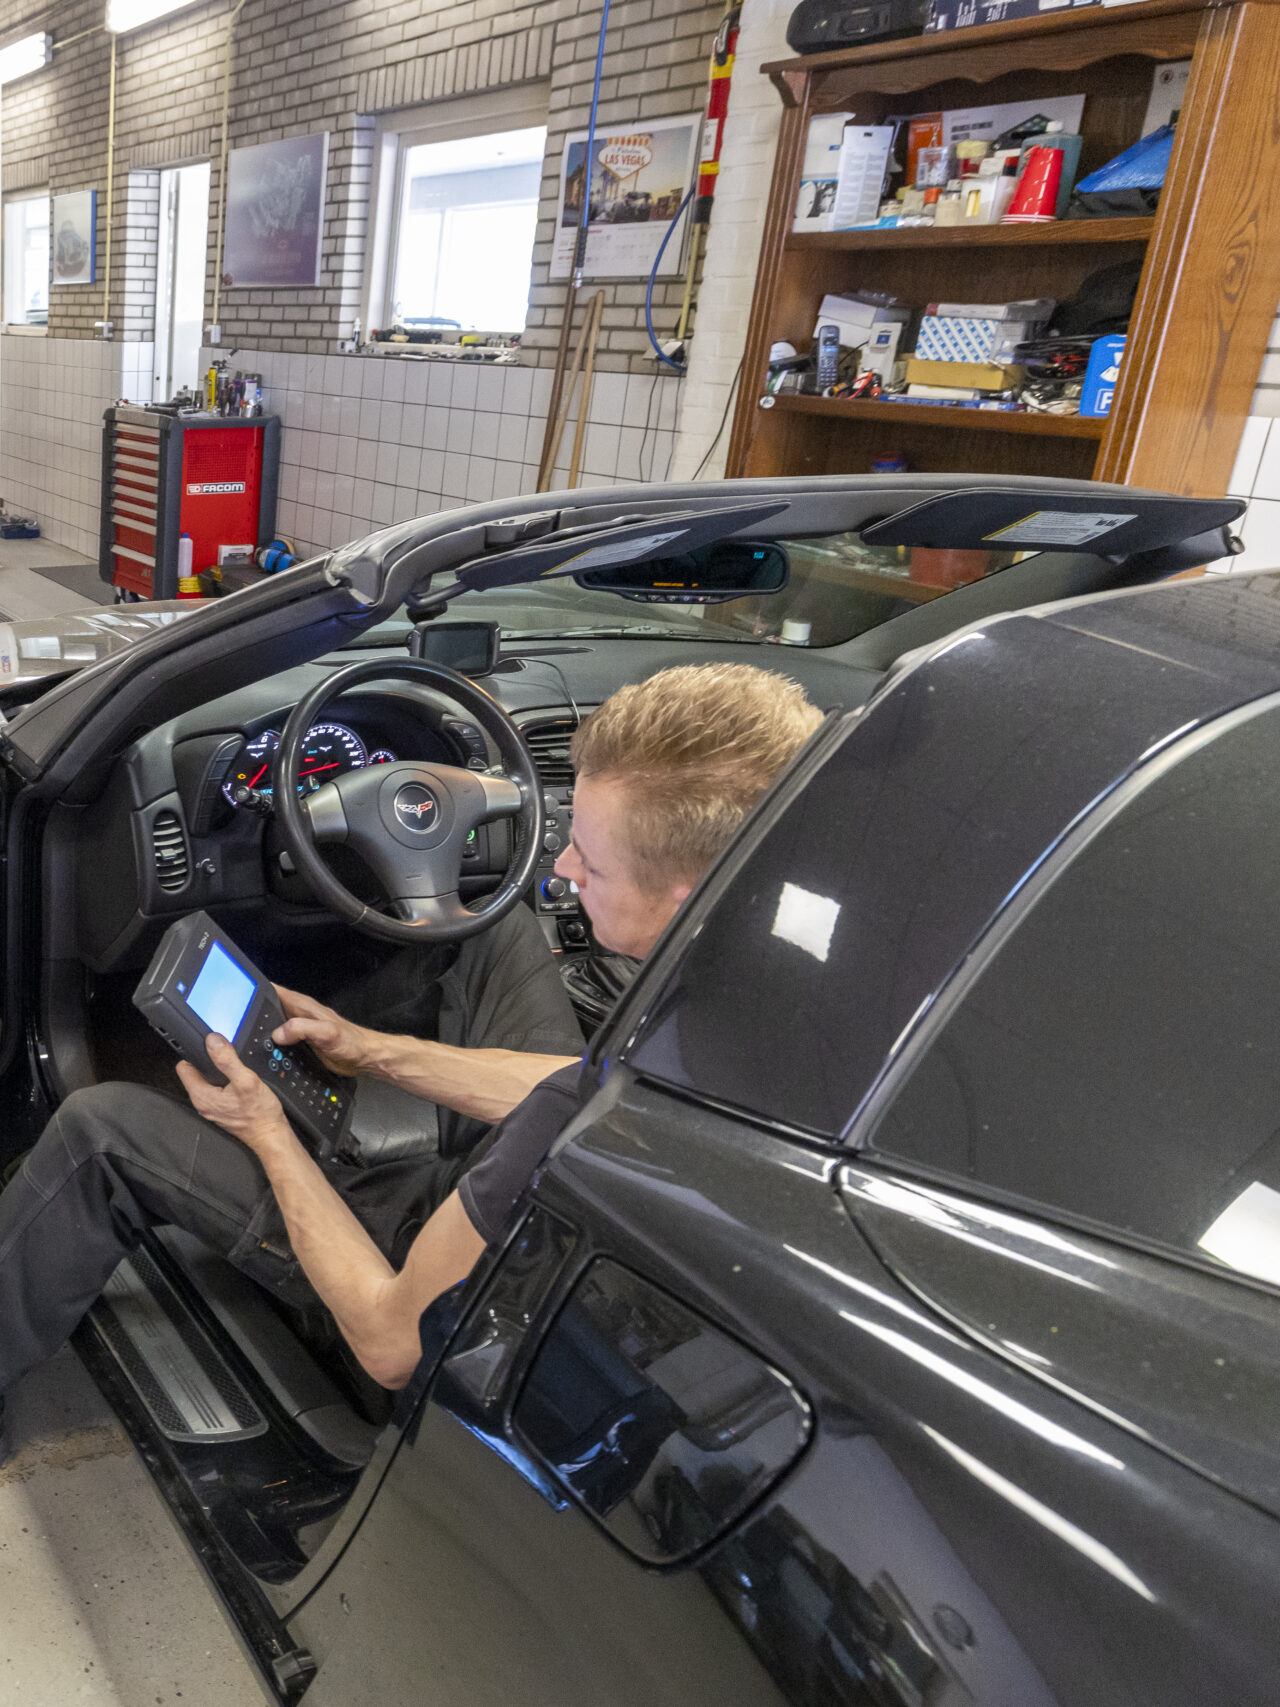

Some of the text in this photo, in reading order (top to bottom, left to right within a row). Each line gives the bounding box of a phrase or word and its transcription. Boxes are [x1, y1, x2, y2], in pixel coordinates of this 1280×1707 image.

[604, 154, 647, 166] LAS VEGAS
[202, 483, 244, 493] FACOM
